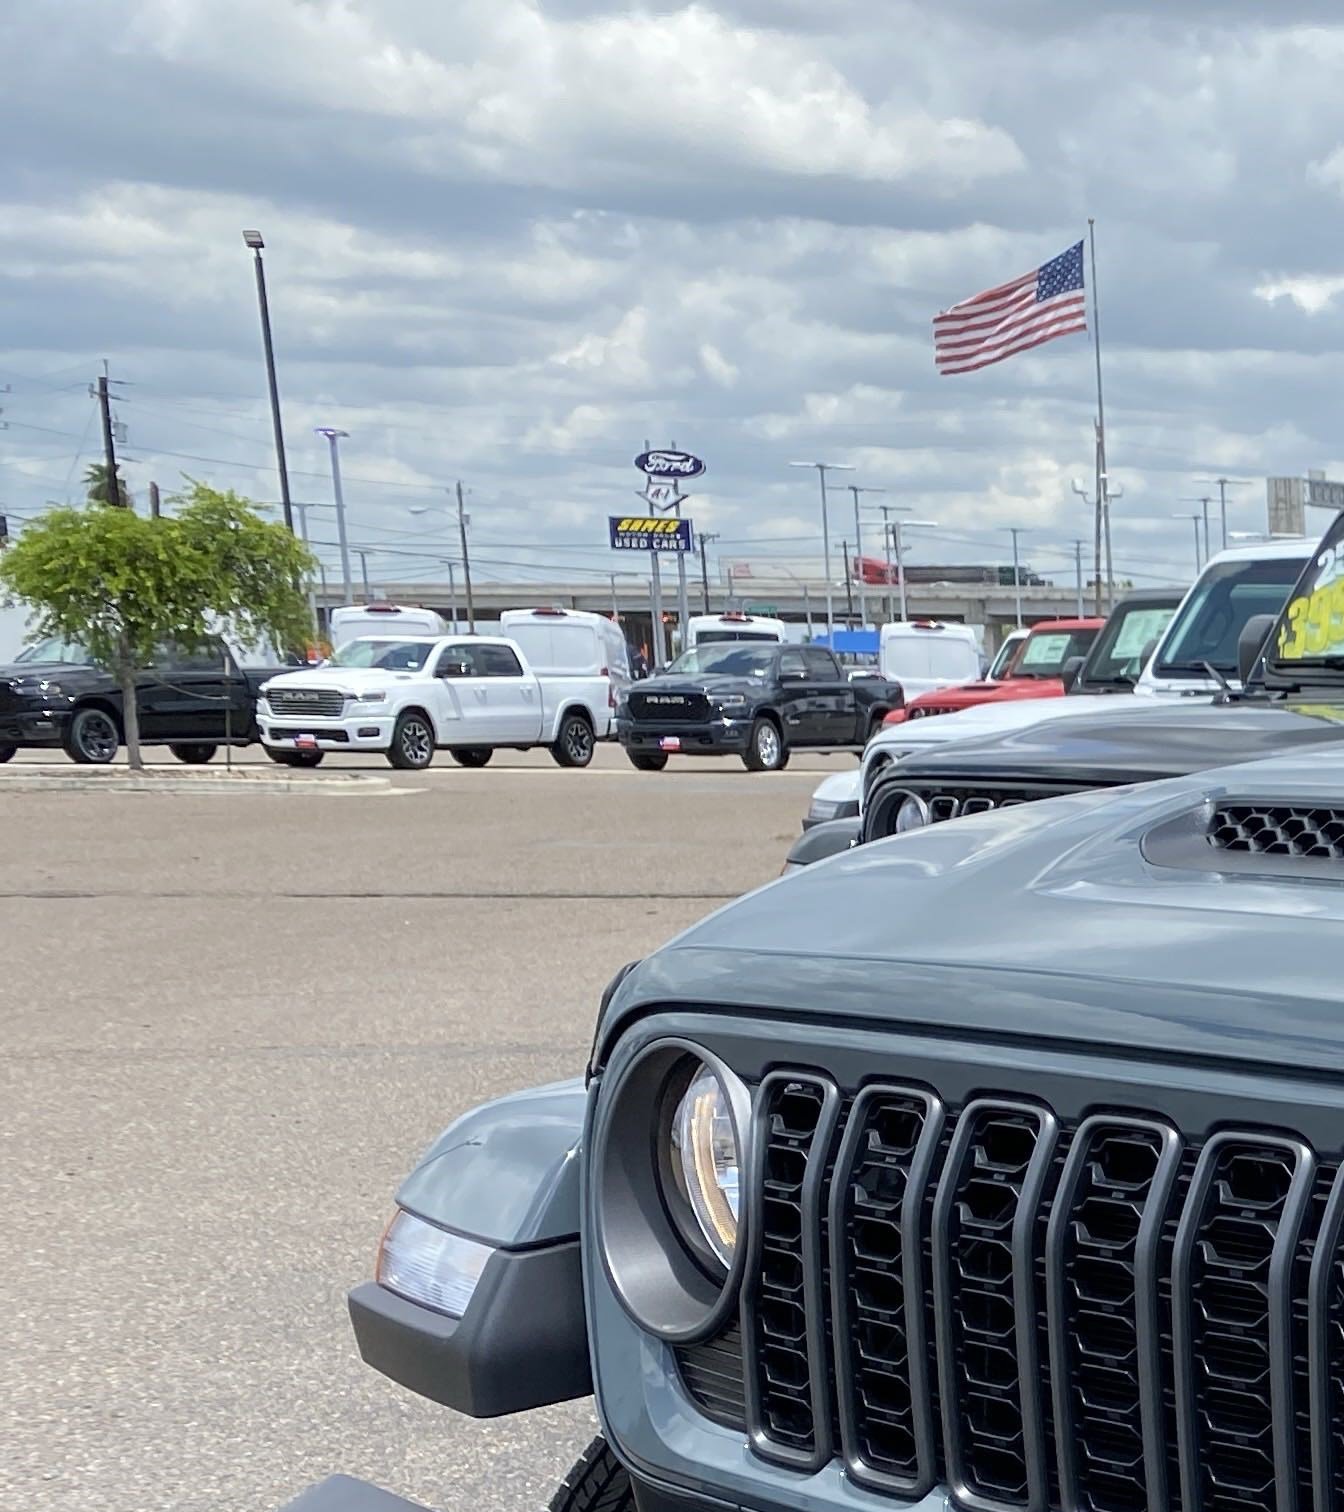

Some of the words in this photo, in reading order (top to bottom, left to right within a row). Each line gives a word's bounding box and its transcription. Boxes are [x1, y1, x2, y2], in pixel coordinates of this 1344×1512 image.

[644, 453, 694, 473] Ford
[615, 537, 648, 549] USED
[652, 539, 686, 550] CARS
